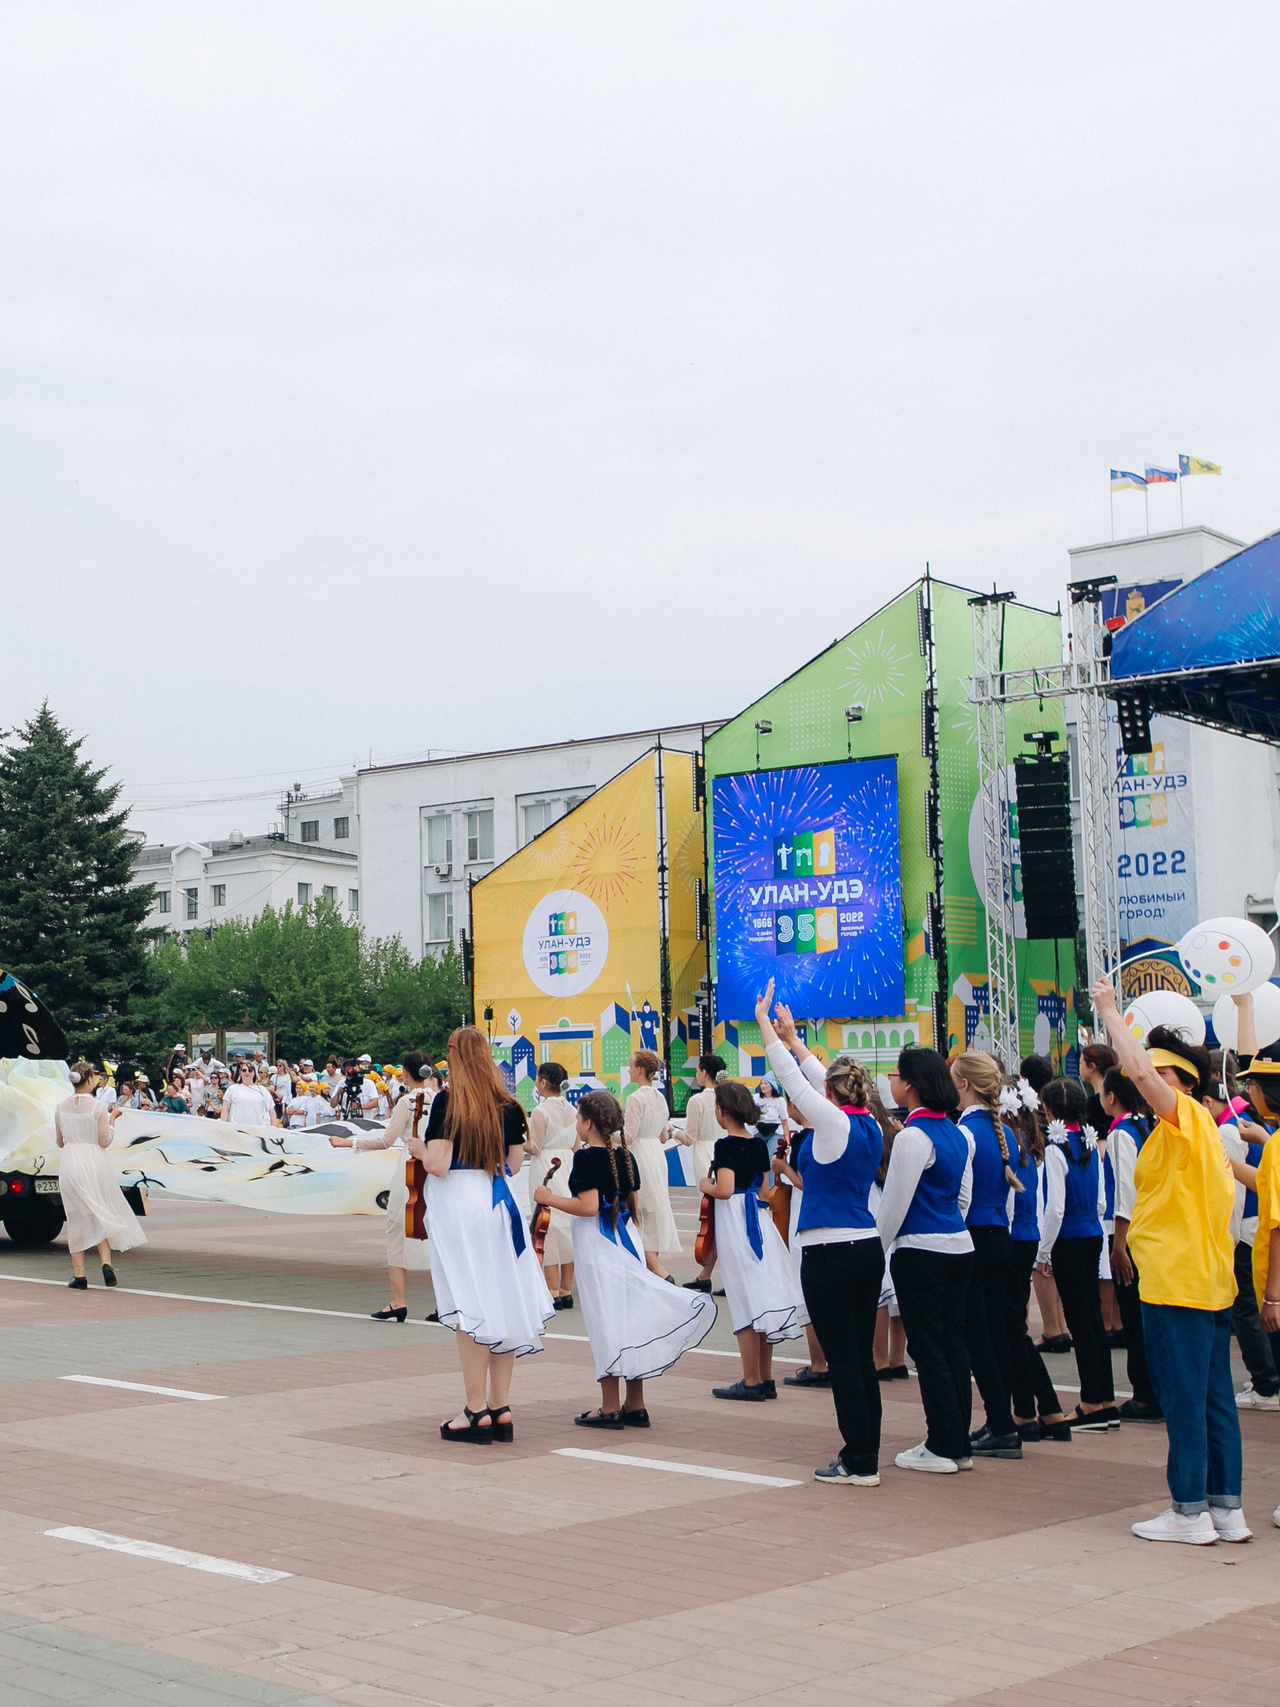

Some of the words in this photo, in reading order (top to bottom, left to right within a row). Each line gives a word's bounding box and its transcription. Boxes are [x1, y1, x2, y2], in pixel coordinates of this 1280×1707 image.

[1106, 774, 1187, 793] ЛАН-УДЭ
[1117, 850, 1186, 878] 2022
[749, 879, 864, 906] УЛАН-УДЭ
[1118, 890, 1186, 905] ЛЮБИМЫЙ
[839, 911, 864, 923] 2022
[1119, 908, 1165, 920] ГОРОД!
[752, 917, 772, 929] 1666
[777, 912, 836, 943] 356
[538, 937, 590, 949] УЛАН-УДЭ
[37, 1181, 59, 1191] Р233
